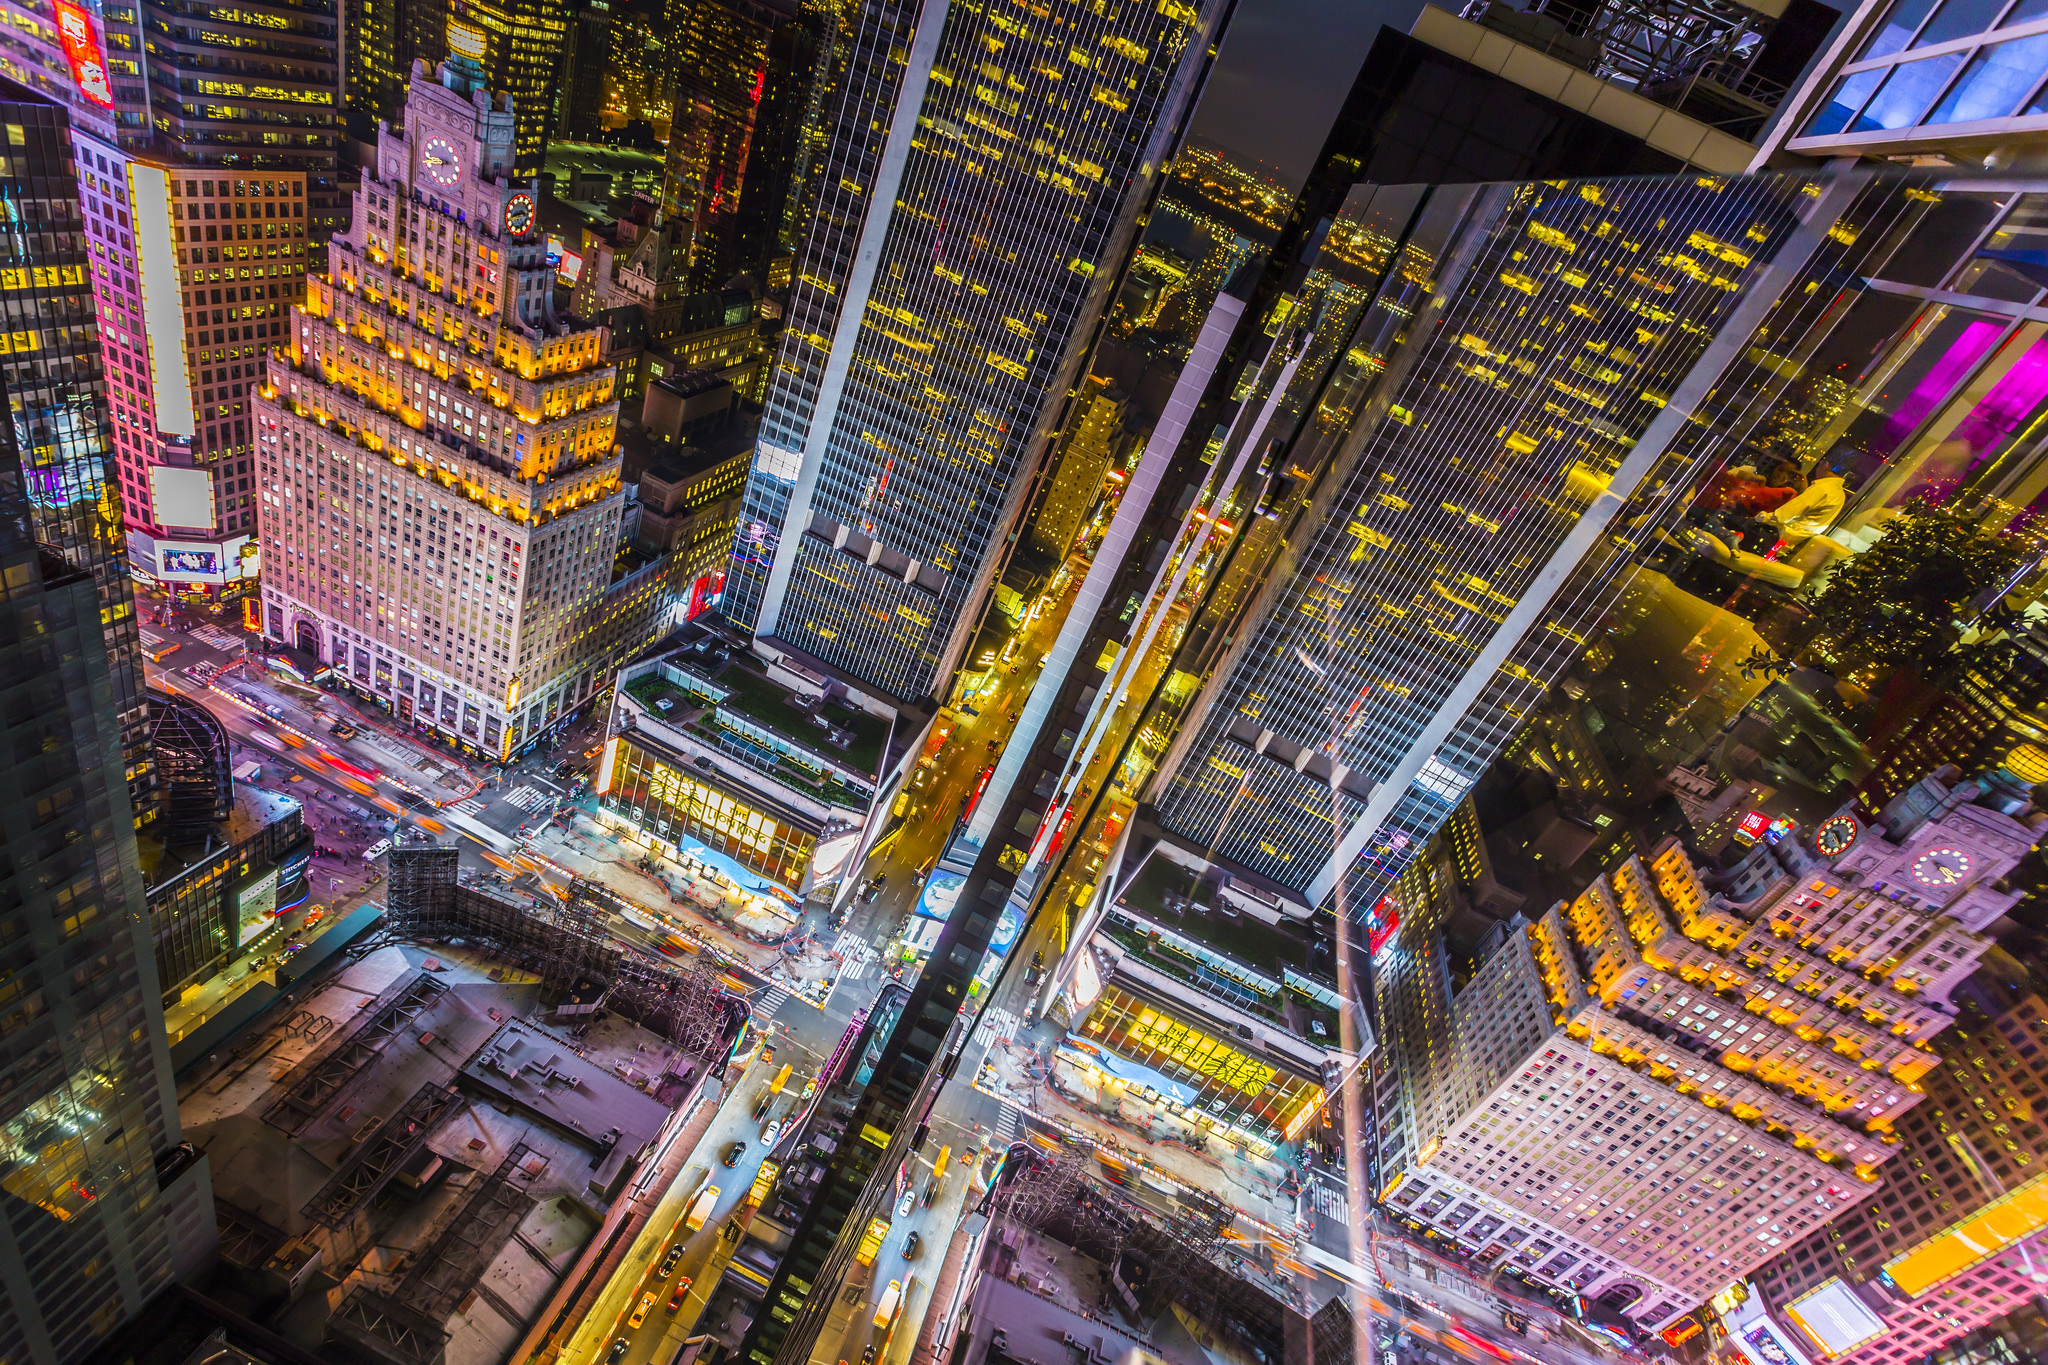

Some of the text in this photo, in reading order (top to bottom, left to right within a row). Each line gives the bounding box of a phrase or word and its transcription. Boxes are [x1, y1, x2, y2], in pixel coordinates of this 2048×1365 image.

[634, 190, 655, 204] CARTER
[729, 806, 747, 820] THE
[707, 806, 767, 845] LION KING
